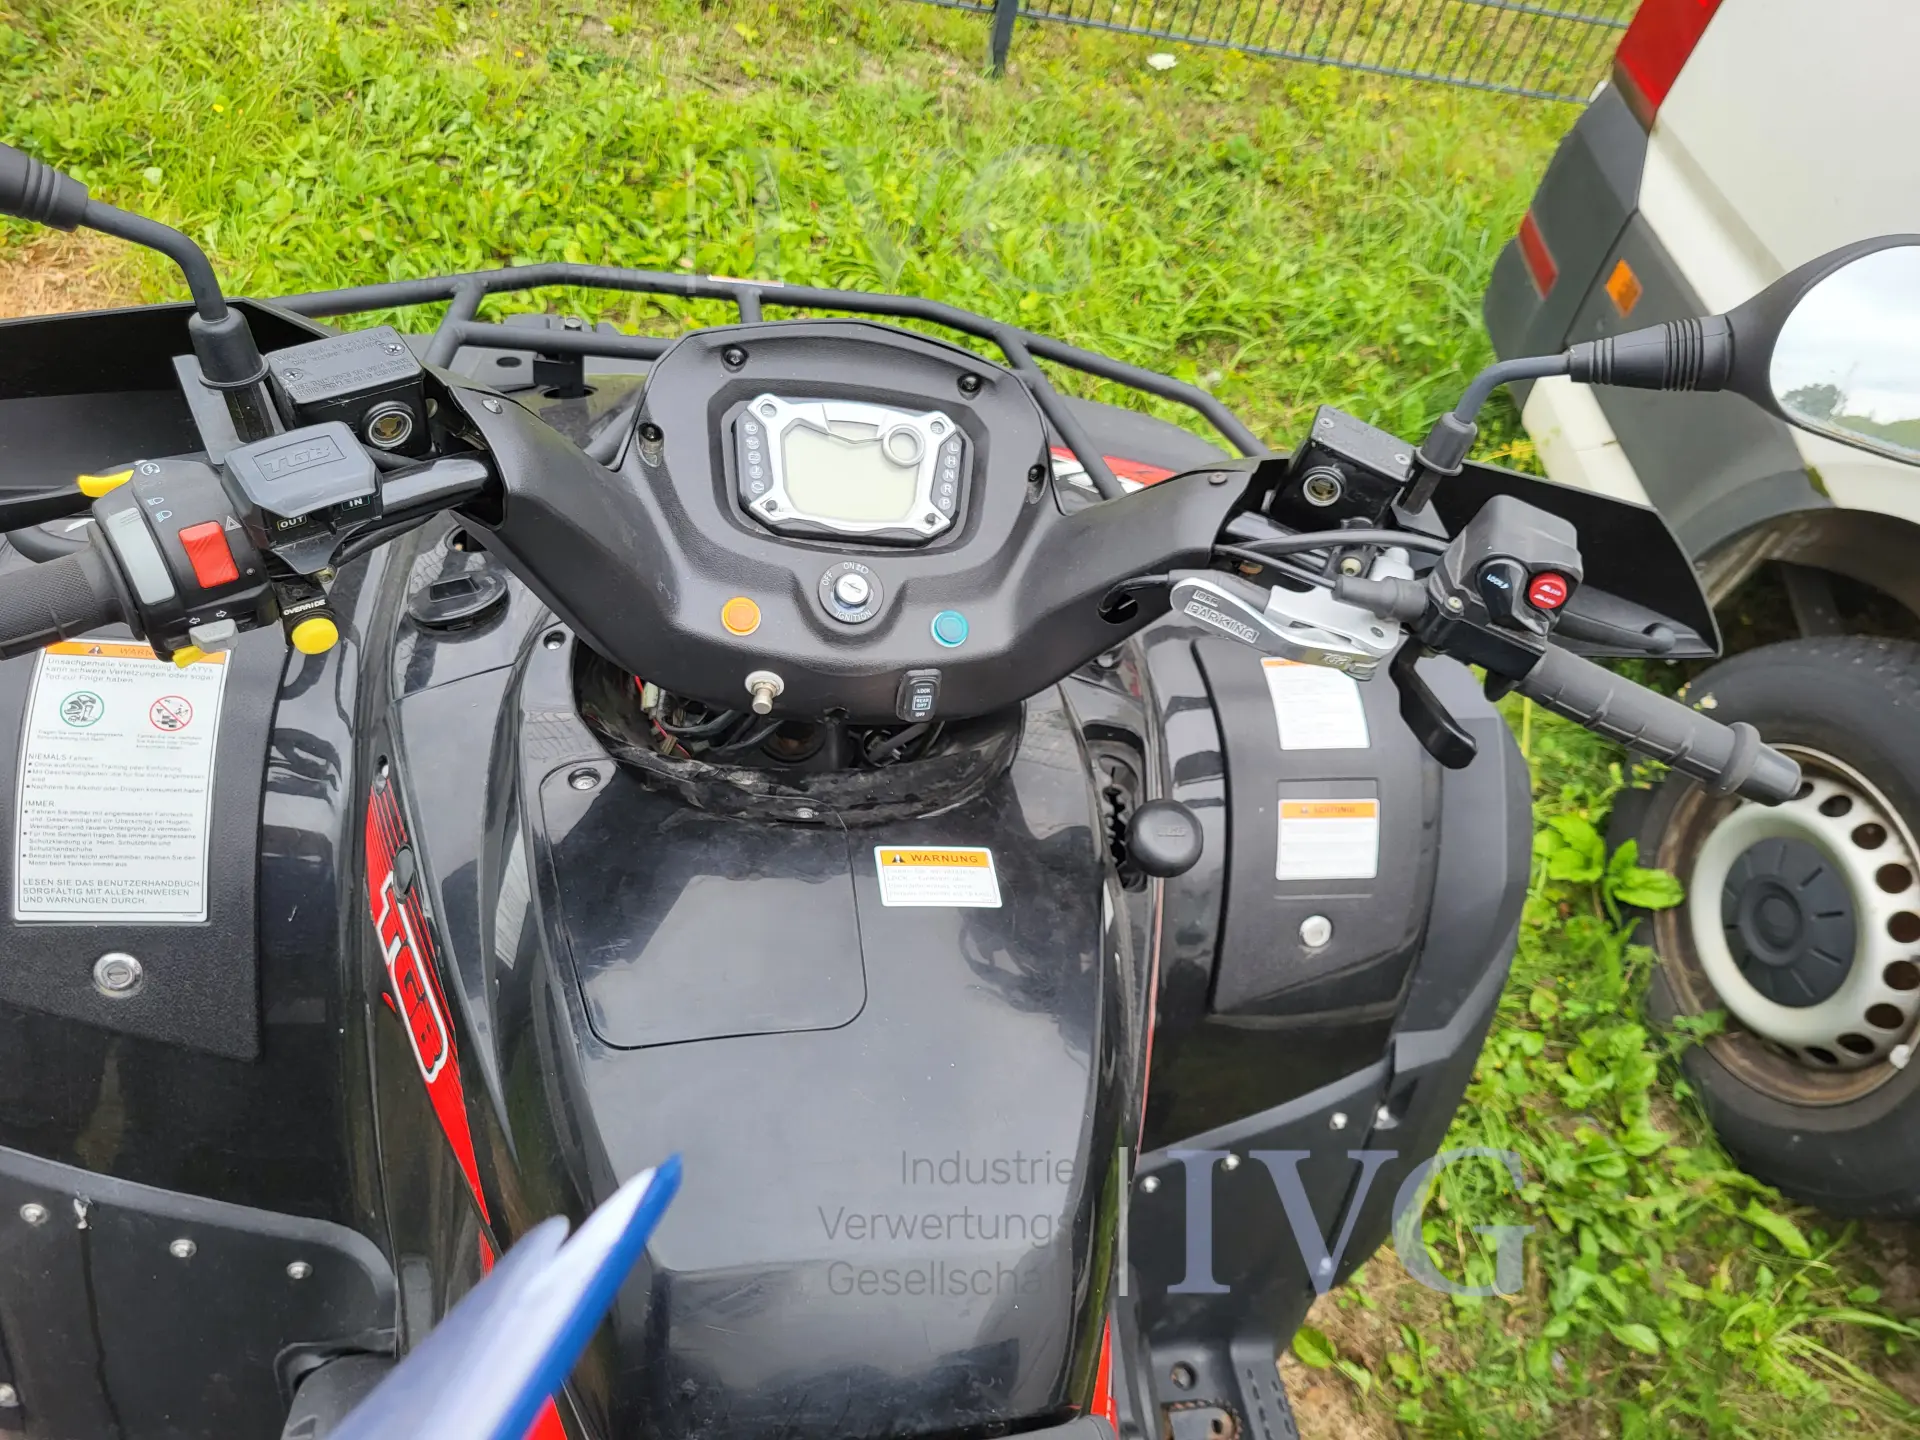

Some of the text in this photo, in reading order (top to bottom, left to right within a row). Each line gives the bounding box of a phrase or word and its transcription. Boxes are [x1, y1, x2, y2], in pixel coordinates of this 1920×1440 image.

[349, 498, 363, 508] IN
[280, 516, 305, 528] OUT
[843, 562, 855, 570] ON
[821, 570, 833, 586] OFF
[283, 599, 327, 616] OVERRIDE
[835, 609, 873, 622] IGNITION
[120, 647, 154, 657] WARN
[28, 752, 67, 761] NIEMALS
[910, 853, 979, 863] WARNUNG
[22, 878, 201, 888] LESEN SIE DAS BENUTZERHANDBUCH
[85, 887, 102, 896] MIT
[104, 887, 134, 896] ALLEN
[137, 888, 191, 897] HINWEISEN
[22, 895, 44, 904] UND
[46, 896, 109, 904] WARNUNGEN
